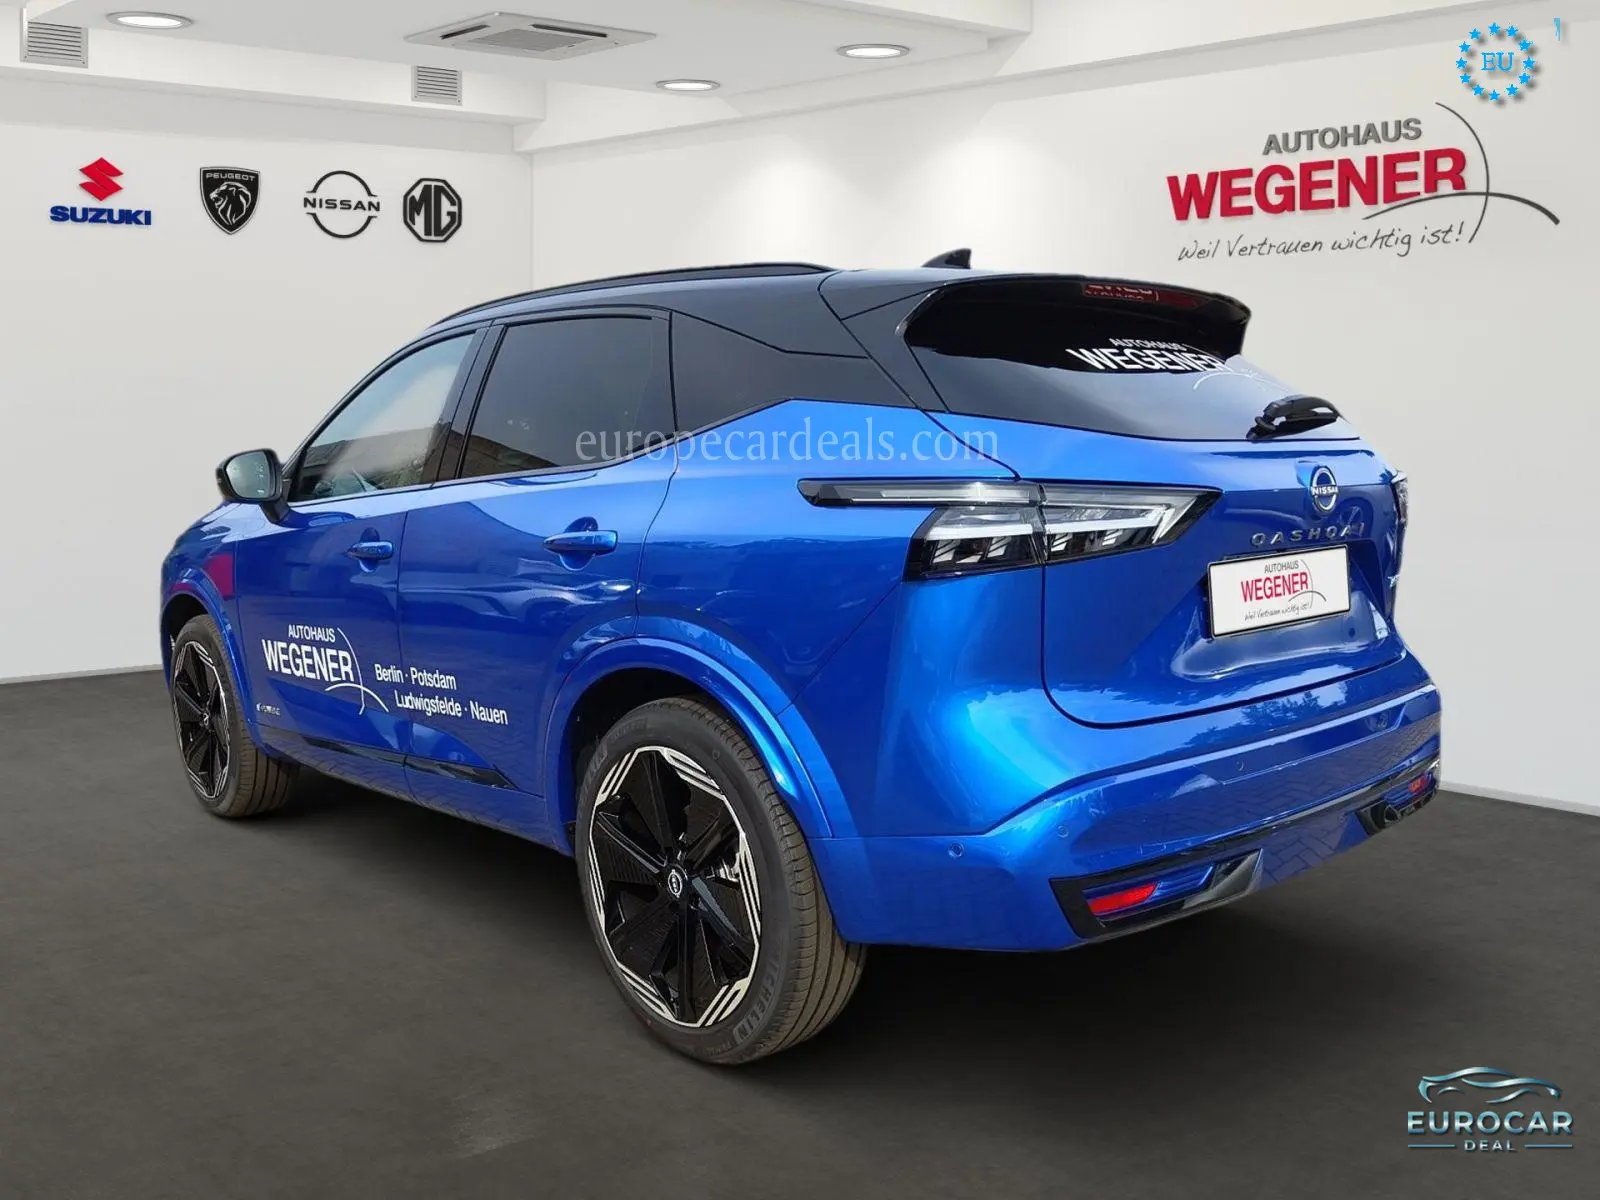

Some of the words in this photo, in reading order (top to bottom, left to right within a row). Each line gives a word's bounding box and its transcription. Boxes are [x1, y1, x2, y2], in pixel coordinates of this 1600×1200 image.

[1263, 118, 1422, 155] AUTOHAUS
[205, 172, 256, 183] PEUGEOT
[1167, 147, 1467, 221] WEGENER
[50, 205, 152, 226] SUZUKI
[304, 196, 380, 212] NISSAN
[407, 184, 458, 237] MG
[1178, 239, 1218, 261] Weil
[1227, 234, 1324, 257] Vertrauen
[1331, 225, 1411, 257] wichtig
[1421, 221, 1464, 246] ist!
[1109, 338, 1188, 351] AUTOHAUS
[1065, 348, 1225, 372] WEGENER
[1252, 523, 1365, 547] QASHQAI
[1264, 560, 1299, 574] AUTOHAUS
[1240, 571, 1309, 603] WEGENER
[288, 624, 336, 643] AUTOHAUS
[261, 639, 354, 683] WEGENER
[374, 663, 404, 684] Berlin
[410, 666, 457, 691] Potsdam
[394, 690, 462, 718] Ludwigsfelde
[471, 701, 508, 725] Nauen
